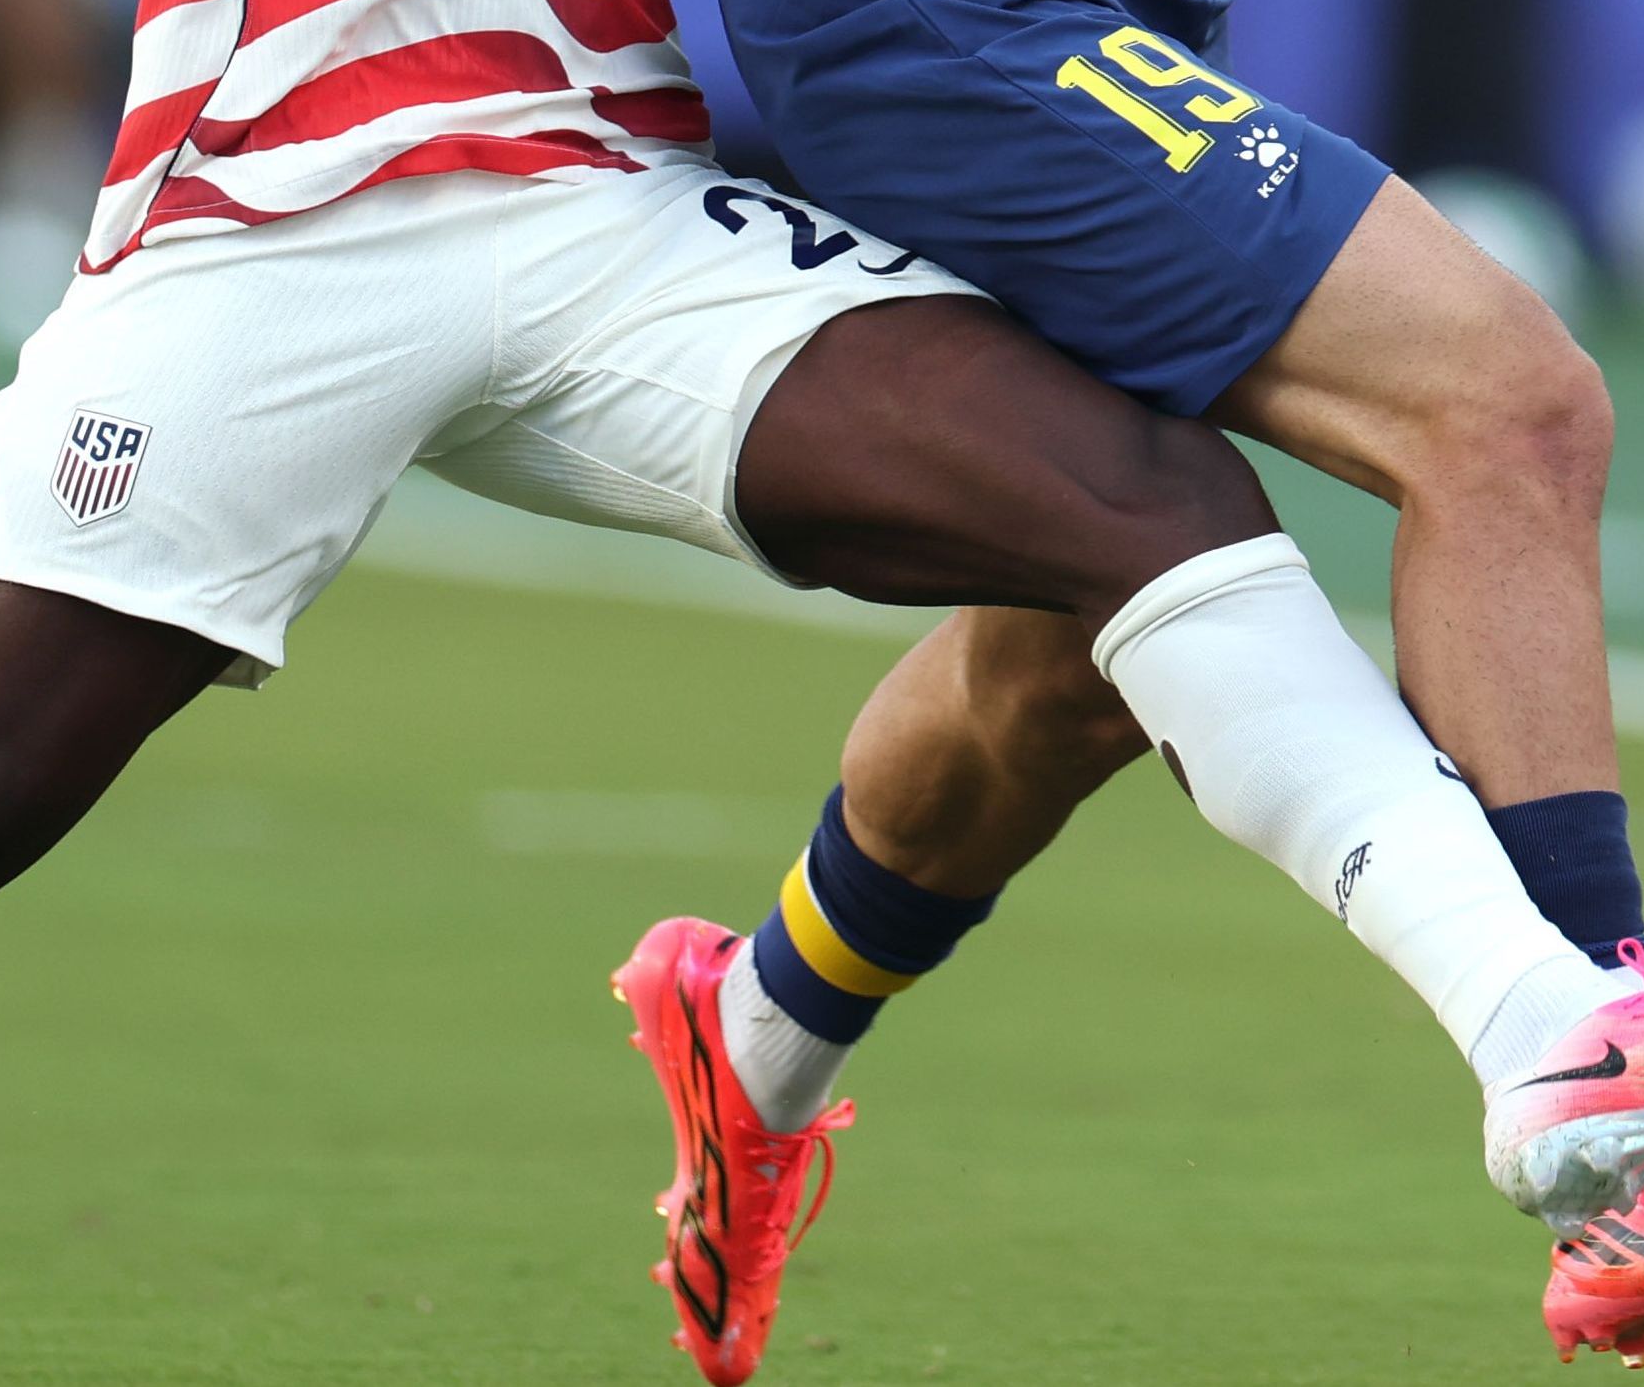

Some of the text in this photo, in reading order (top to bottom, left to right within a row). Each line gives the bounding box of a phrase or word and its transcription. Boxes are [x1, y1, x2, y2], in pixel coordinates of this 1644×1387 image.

[1057, 26, 1265, 173] 19
[703, 185, 920, 275] 2
[71, 416, 144, 462] USA
